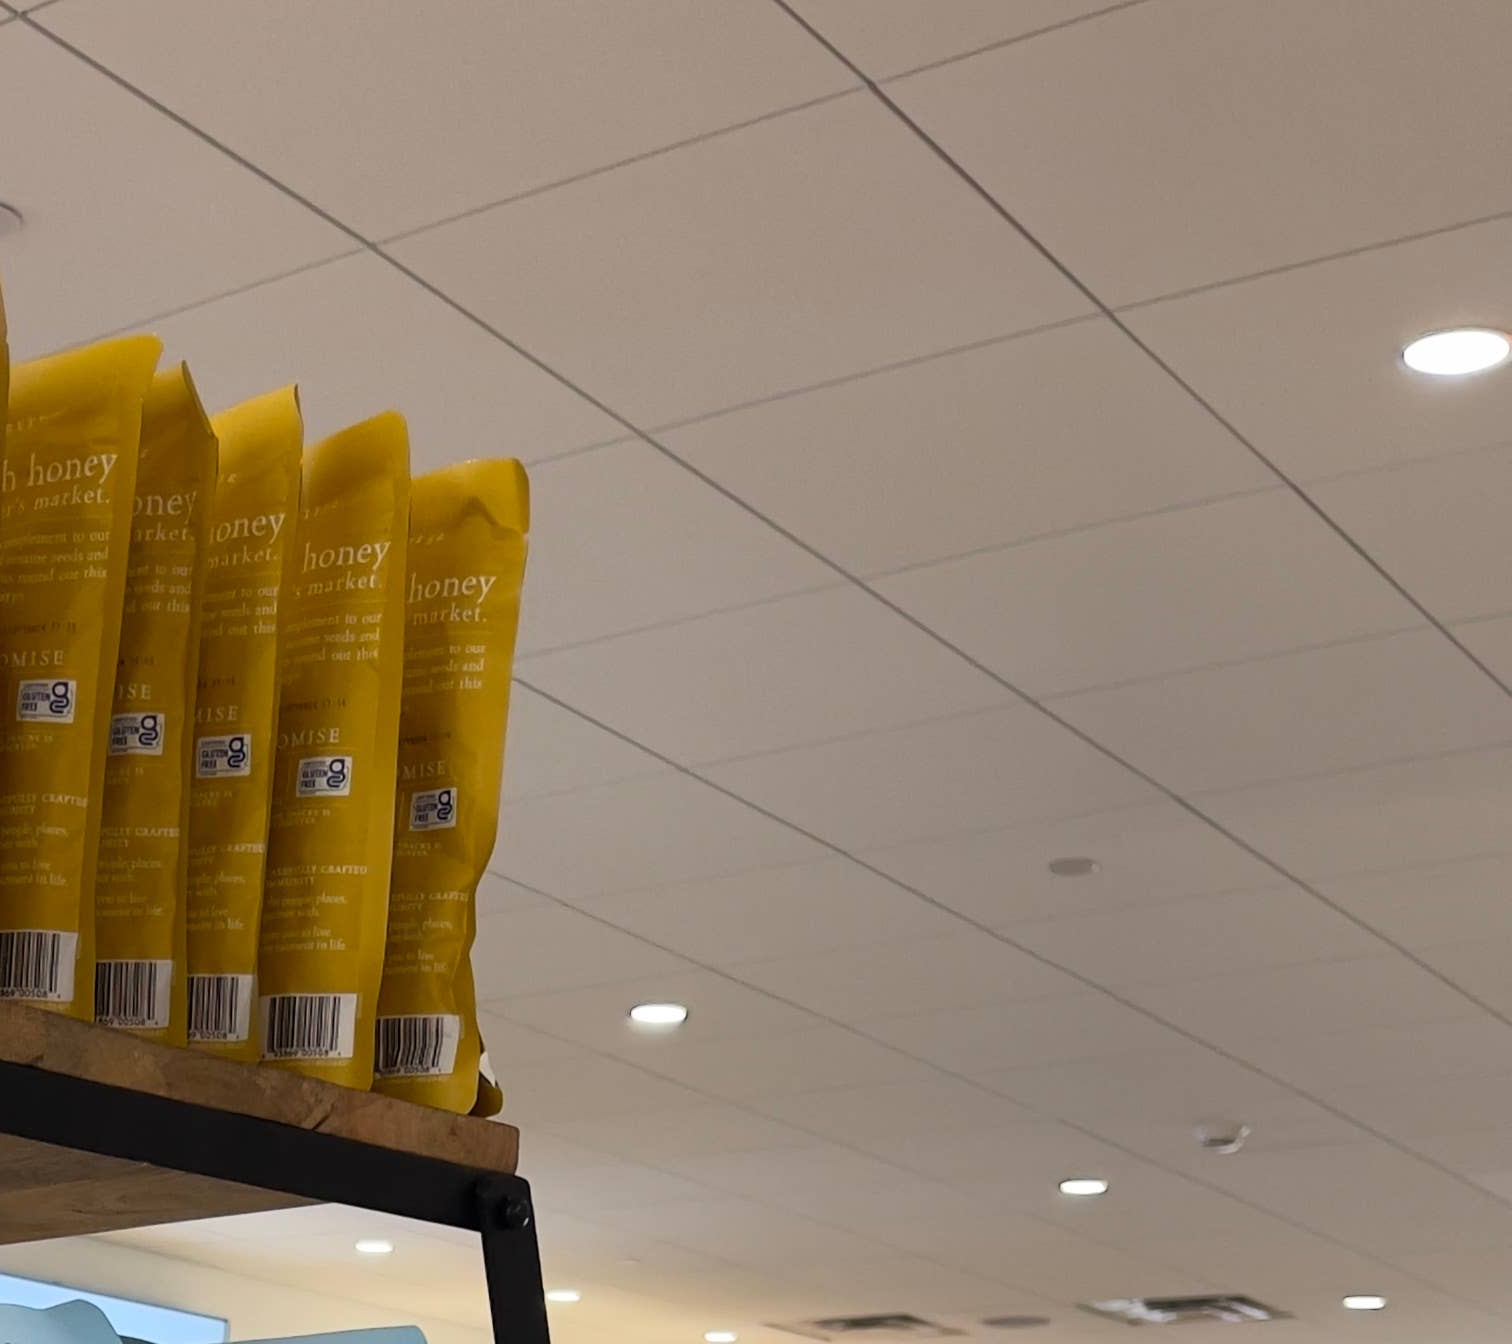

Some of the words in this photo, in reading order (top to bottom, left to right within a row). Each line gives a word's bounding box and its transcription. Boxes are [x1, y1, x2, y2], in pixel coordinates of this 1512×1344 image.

[28, 451, 118, 489] honey
[303, 540, 392, 573] honey
[408, 572, 496, 604] honey
